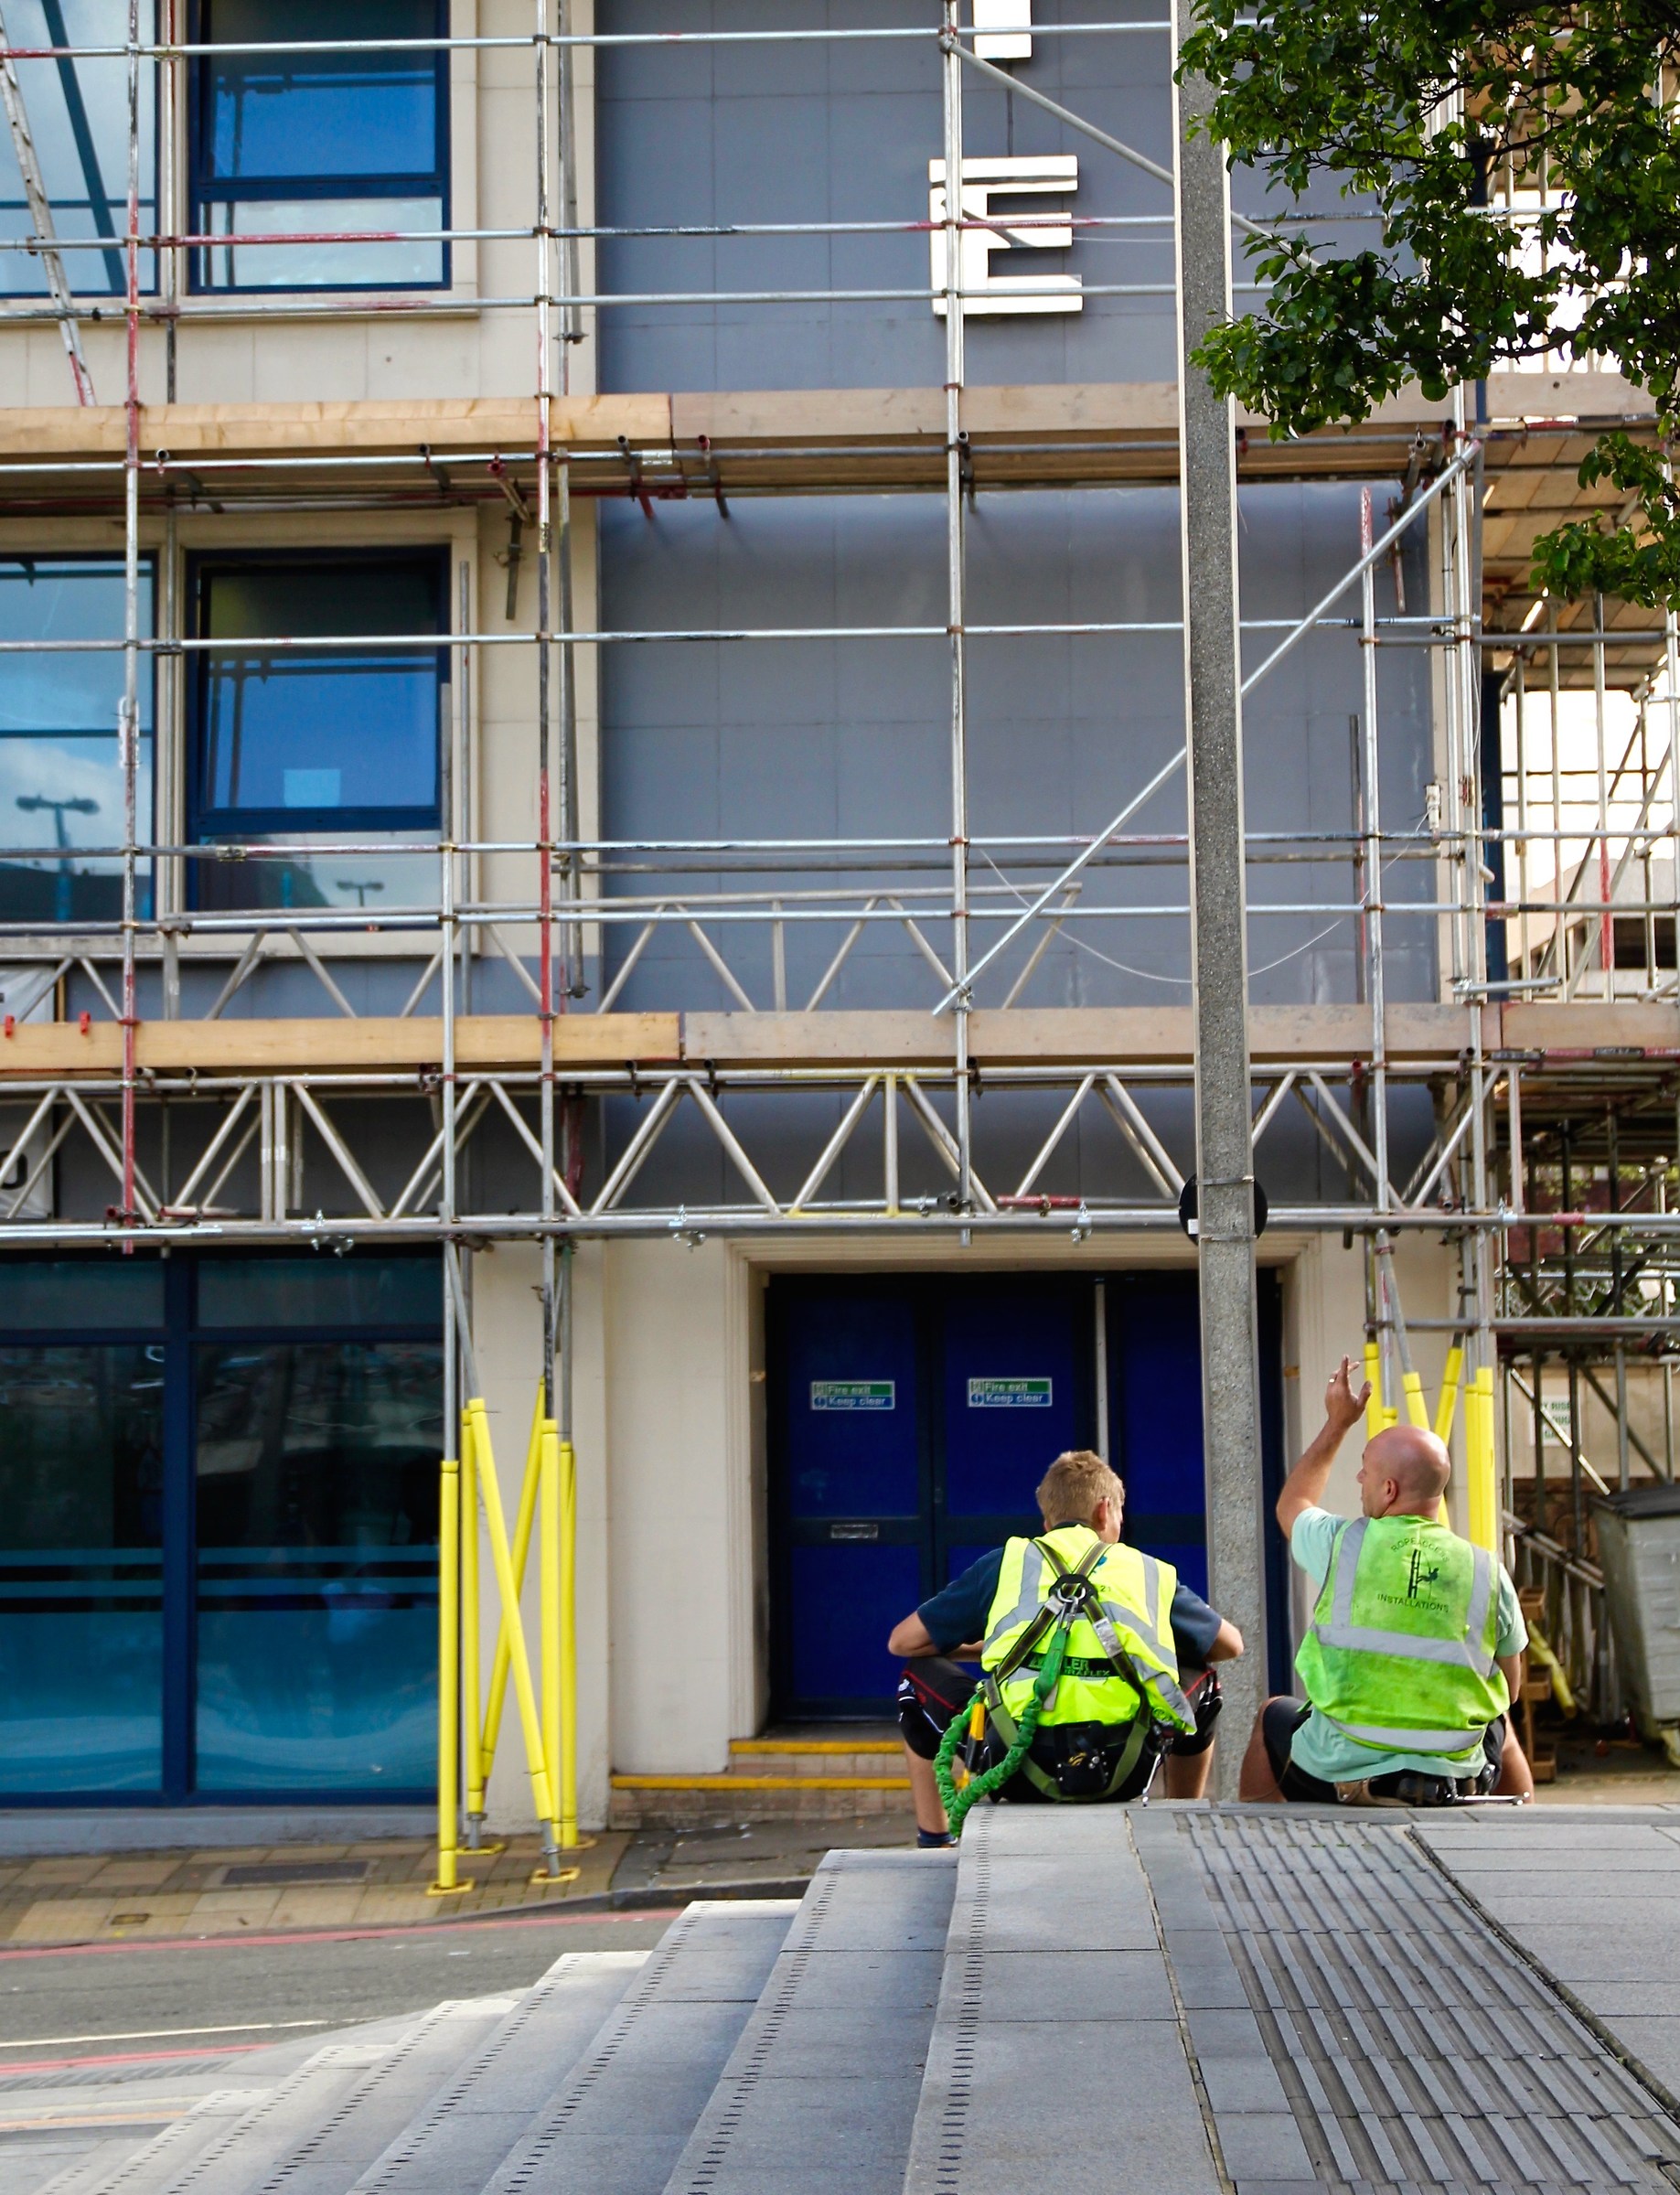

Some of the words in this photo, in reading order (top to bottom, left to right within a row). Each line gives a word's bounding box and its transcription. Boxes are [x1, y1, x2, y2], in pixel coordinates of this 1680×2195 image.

[827, 1385, 850, 1395] Fire
[851, 1385, 871, 1395] exit
[984, 1382, 1006, 1392] Fire
[1008, 1382, 1028, 1392] exit
[829, 1397, 857, 1408] Keep
[859, 1397, 885, 1407] clear
[986, 1393, 1014, 1404] Keep
[1016, 1393, 1043, 1403] clear
[1391, 1537, 1417, 1553] ROPE
[1377, 1593, 1450, 1613] INSTALLATIONS
